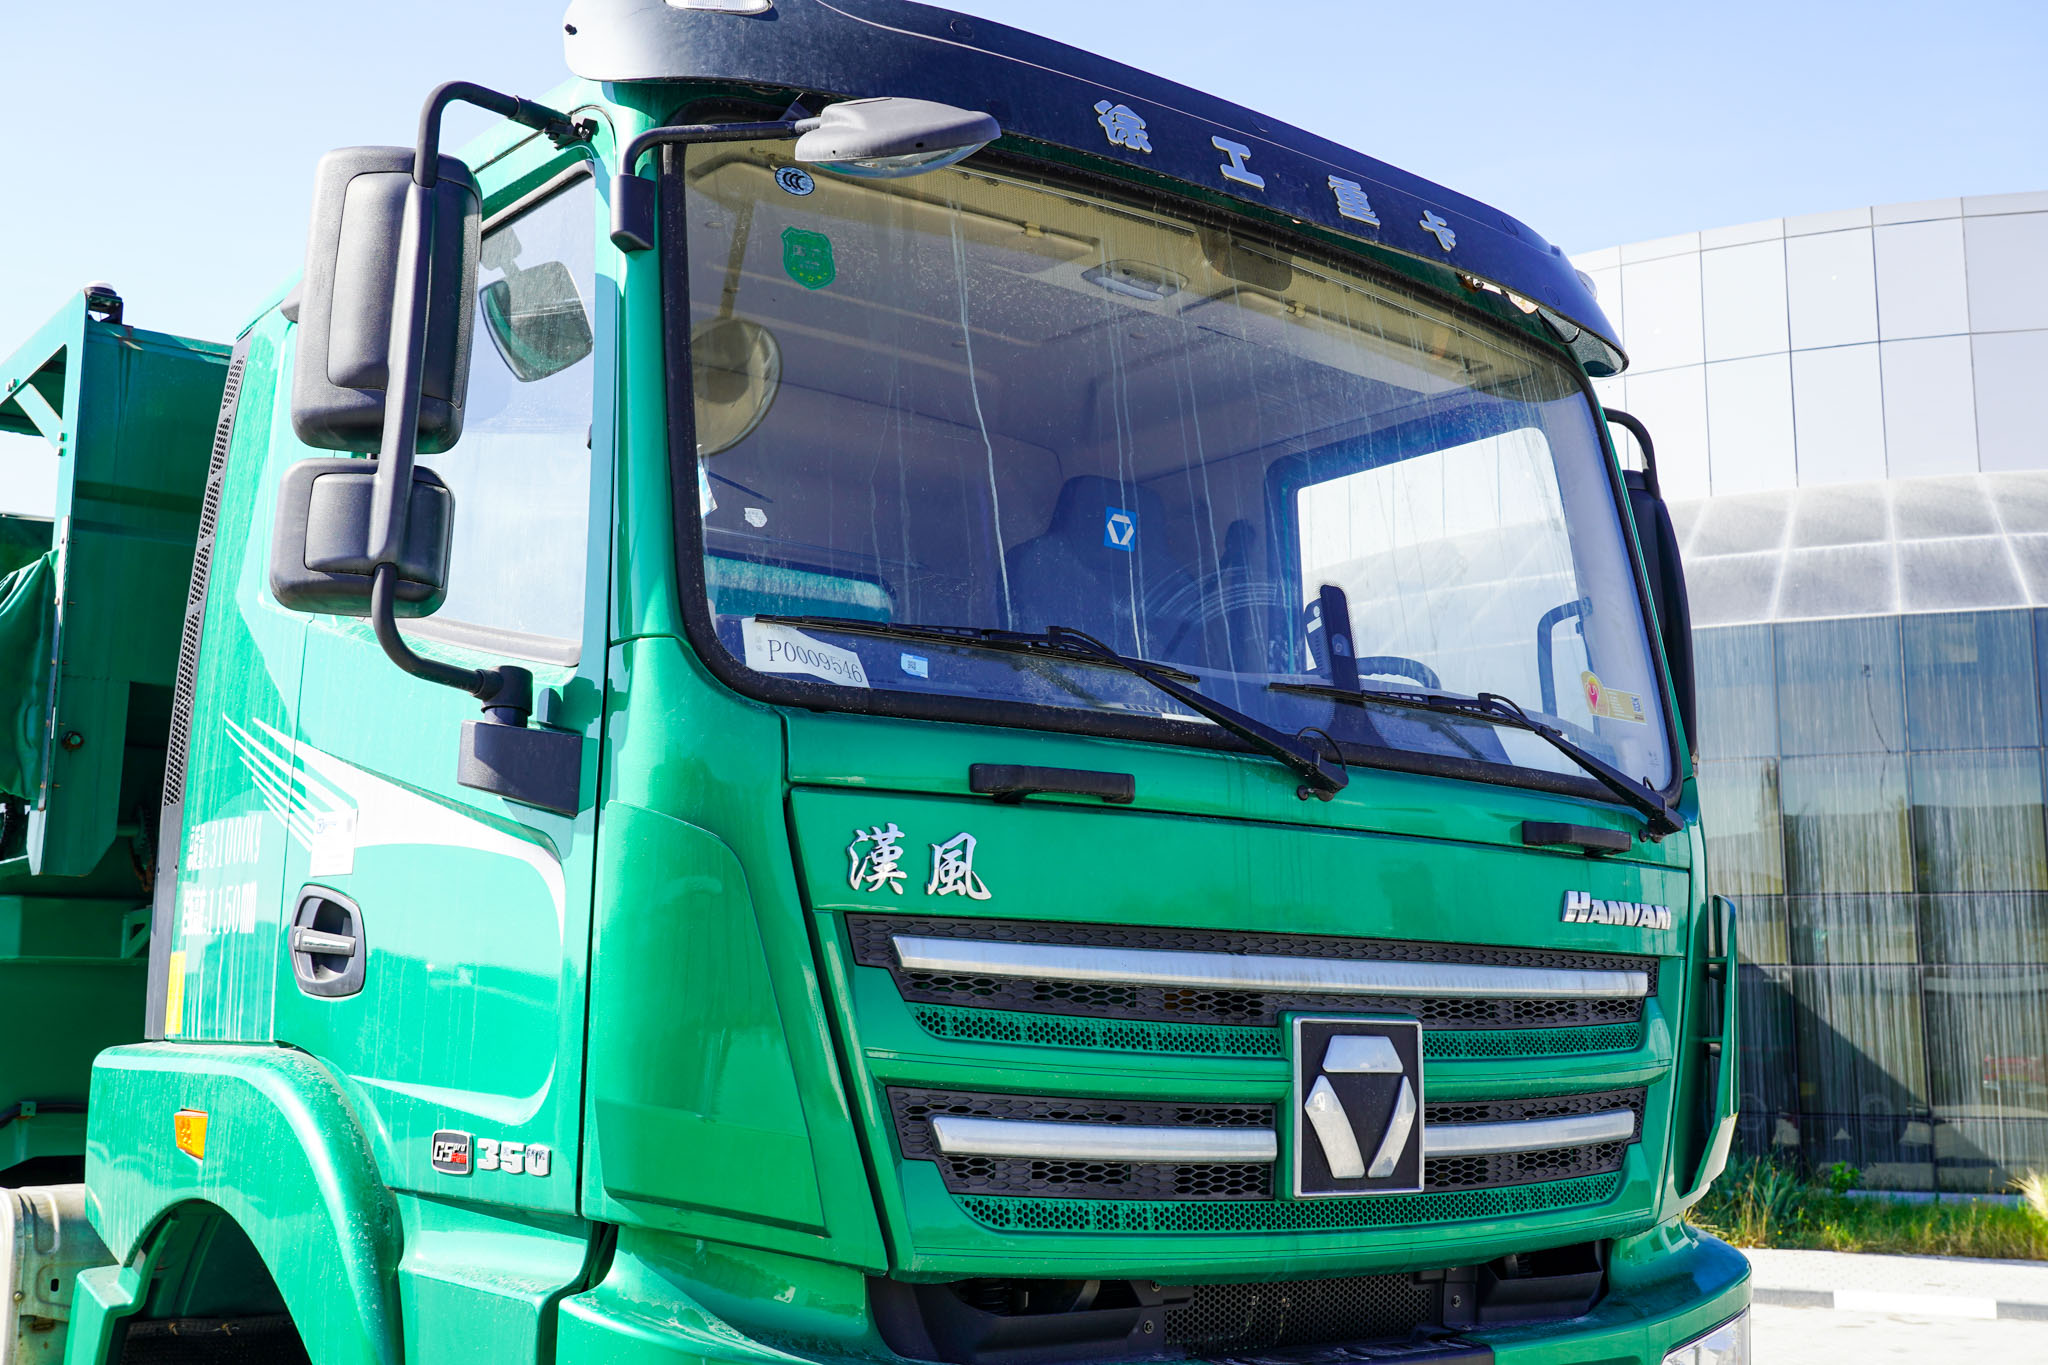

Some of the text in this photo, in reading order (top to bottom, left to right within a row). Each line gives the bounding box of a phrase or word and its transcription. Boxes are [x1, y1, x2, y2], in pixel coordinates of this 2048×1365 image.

[1093, 99, 1456, 251] 徐工重卡
[767, 639, 863, 683] P0009546
[847, 822, 992, 901] 漢風
[477, 1138, 552, 1176] 350
